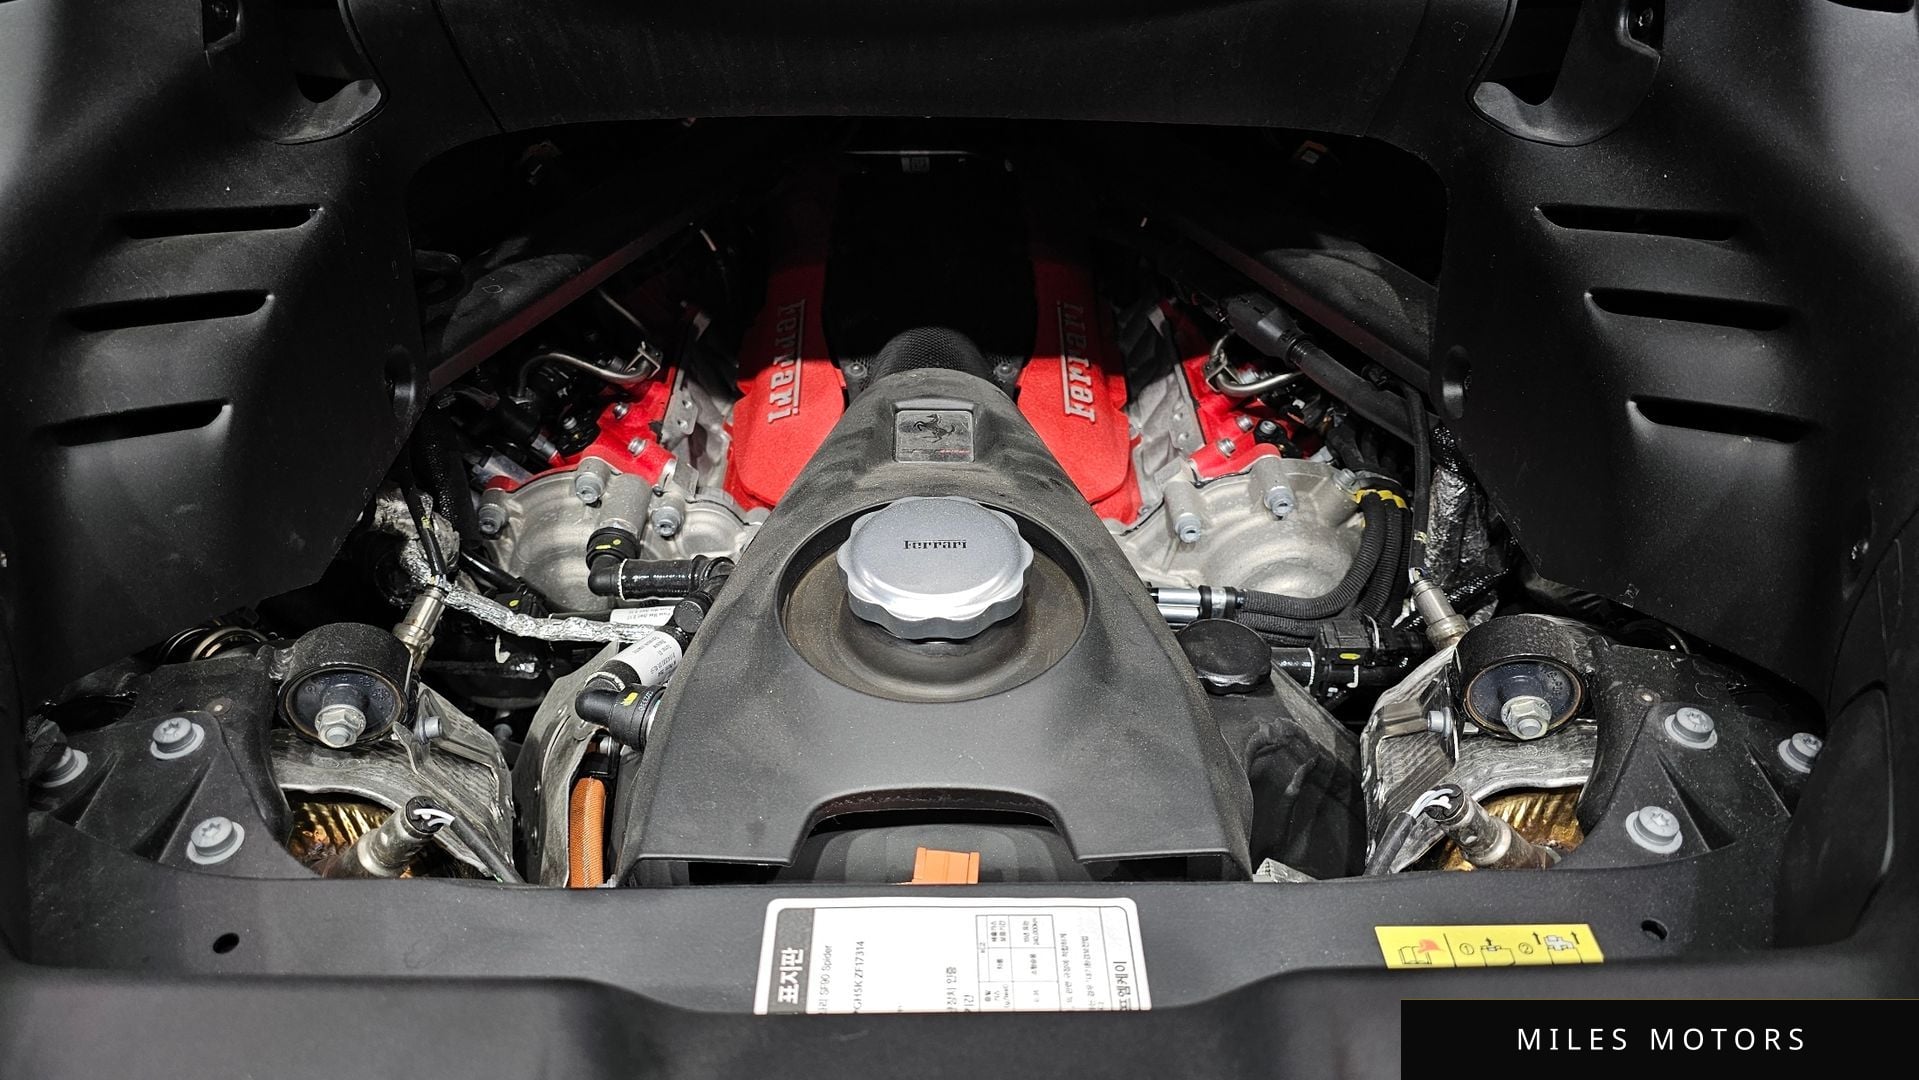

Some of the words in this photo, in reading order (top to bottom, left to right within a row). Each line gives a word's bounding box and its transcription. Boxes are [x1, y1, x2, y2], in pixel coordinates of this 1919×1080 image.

[768, 299, 805, 424] Ferrari
[1057, 300, 1096, 423] Ferrari
[903, 539, 967, 550] Ferrari
[821, 945, 832, 971] Spider
[854, 940, 865, 979] ZF17314
[777, 947, 804, 1005] 표지판
[819, 973, 830, 996] SF90
[946, 966, 957, 984] 인증
